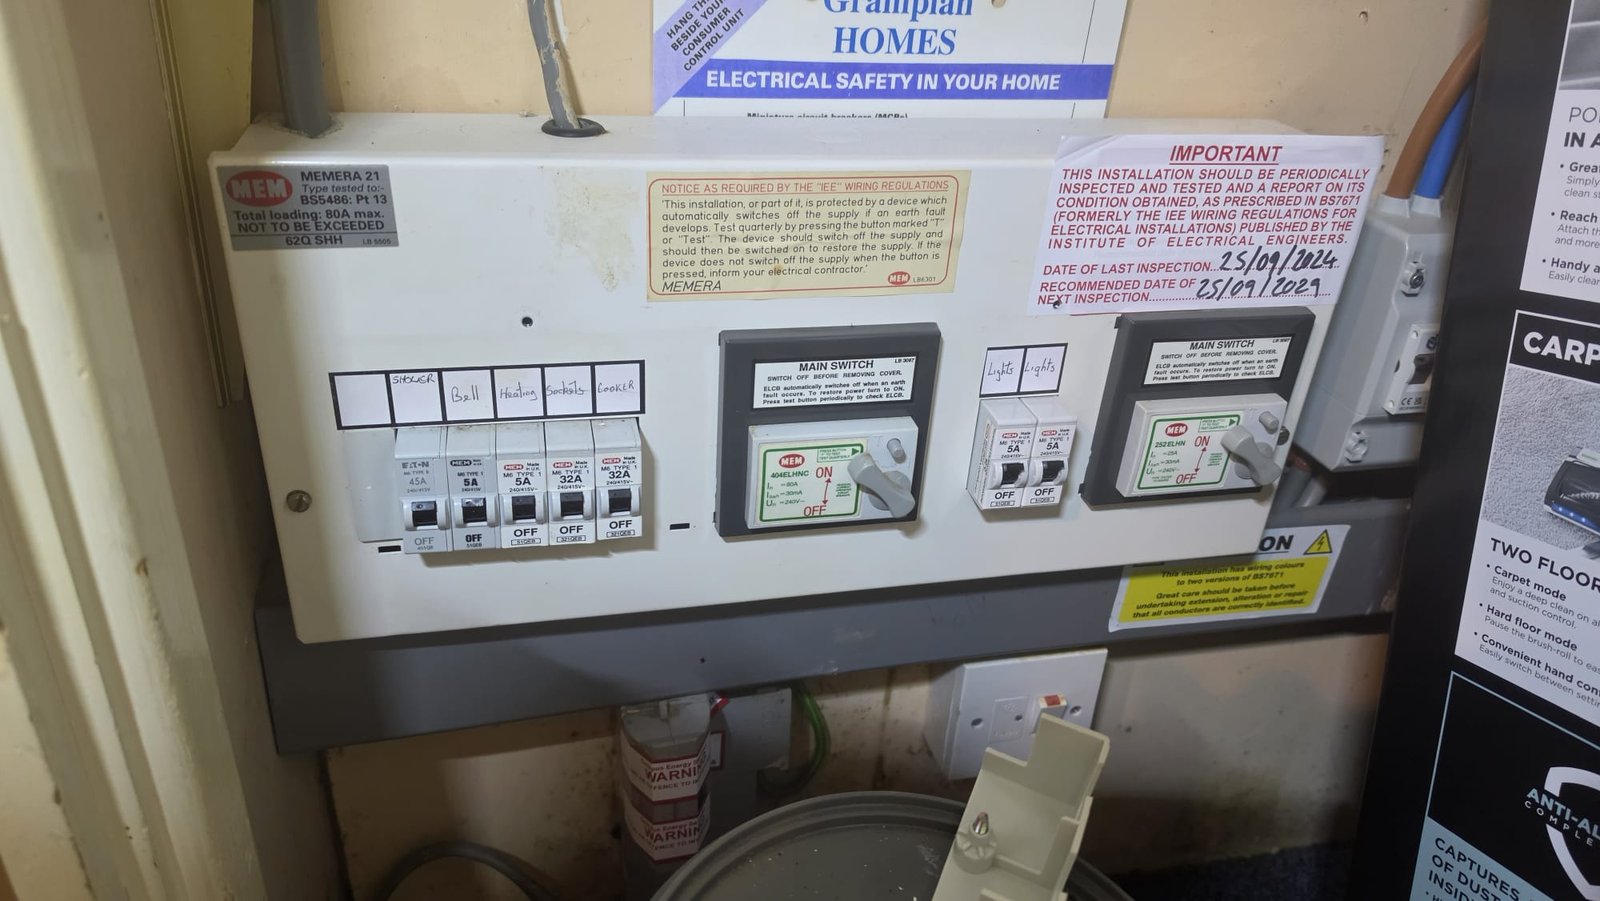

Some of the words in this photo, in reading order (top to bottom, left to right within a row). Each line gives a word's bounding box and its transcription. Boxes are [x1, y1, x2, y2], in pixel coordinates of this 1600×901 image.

[667, 11, 693, 39] HANG
[671, 19, 702, 51] BESIDE
[682, 7, 731, 56] CONSUMER
[684, 34, 724, 71] CONTROL
[722, 8, 744, 32] UNIT
[832, 27, 956, 55] HOMES
[707, 70, 832, 89] ELECTRICAL
[836, 72, 914, 89] SAFETY
[917, 73, 938, 90] IN
[943, 74, 998, 90] YOUR
[1002, 74, 1061, 90] HOME
[1564, 132, 1585, 148] IN
[1170, 145, 1283, 161] IMPORTANT
[300, 171, 362, 182] MEMERA
[365, 171, 379, 181] 21
[1063, 169, 1092, 180] THIS
[1098, 168, 1194, 180] INSTALLATION
[1198, 169, 1253, 180] SHOULD
[1257, 169, 1276, 180] BE
[1279, 169, 1370, 179] PERIODICALLY
[231, 180, 287, 199] MEM
[302, 184, 328, 193] Type
[331, 183, 364, 193] tested
[662, 184, 700, 194] NOTICE
[703, 184, 718, 193] AS
[721, 183, 774, 193] REQUIRED
[777, 183, 790, 192] BY
[794, 182, 813, 192] THE
[844, 181, 878, 191] WIRING
[881, 180, 949, 190] REGULATIONS
[1059, 183, 1135, 194] INSPECTED
[1138, 182, 1168, 194] AND
[1173, 182, 1222, 193] TESTED
[1225, 182, 1254, 193] AND
[1257, 182, 1265, 193] A
[1270, 182, 1323, 193] REPORT
[1325, 182, 1344, 193] ON
[1346, 182, 1365, 193] ITS
[1564, 188, 1590, 197] clean
[300, 194, 352, 205] BS5486:
[356, 194, 369, 205] Pt
[373, 194, 387, 204] 13
[689, 199, 746, 209] installation,
[761, 199, 781, 209] part
[783, 198, 793, 208] of
[816, 197, 863, 208] protected
[865, 197, 877, 207] by
[887, 197, 918, 206] device
[920, 196, 947, 205] which
[233, 210, 266, 220] Total
[269, 209, 322, 221] loading:
[325, 209, 351, 219] 80A
[354, 211, 384, 219] max.
[1560, 210, 1598, 224] Reach
[238, 223, 266, 232] NOT
[270, 222, 290, 232] TO
[293, 221, 311, 232] BE
[314, 220, 384, 231] EXCEEDED
[1557, 224, 1589, 236] Attach
[286, 236, 312, 245] 62Q
[314, 235, 344, 245] SHH
[1220, 245, 1338, 276] 25/09/2024
[1551, 258, 1590, 274] Handy
[1043, 264, 1077, 275] DATE
[1080, 264, 1098, 274] OF
[1101, 263, 1135, 274] LAST
[889, 274, 908, 283] MEM
[1548, 270, 1575, 284] Easily
[662, 280, 721, 292] MEMERA
[1040, 280, 1141, 292] RECOMMENDED
[1143, 279, 1176, 289] DATE
[1179, 279, 1197, 288] OF
[1196, 277, 1320, 301] 25/09/2029
[1037, 294, 1072, 305] NEXT
[1189, 341, 1215, 350] MAIN
[1216, 340, 1255, 349] SWITCH
[1524, 332, 1600, 365] CARP
[799, 362, 828, 372] MAIN
[830, 360, 874, 370] SWITCH
[988, 361, 1014, 381] Lights
[1024, 358, 1056, 377] Lights
[452, 385, 480, 403] Bell
[500, 386, 538, 401] Heating
[1166, 424, 1186, 435] MEM
[1194, 436, 1210, 447] ON
[781, 457, 803, 465] MEM
[608, 470, 630, 479] 32A
[816, 466, 832, 478] ON
[409, 477, 427, 485] 45A
[464, 478, 478, 486] 5A
[515, 477, 531, 486] 5A
[559, 474, 582, 483] 32A
[1176, 473, 1197, 484] OFF
[994, 491, 1015, 500] OFF
[1034, 488, 1056, 496] OFF
[804, 505, 827, 517] OFF
[559, 525, 584, 534] OFF
[609, 520, 633, 529] OFF
[466, 534, 482, 543] OFF
[513, 528, 538, 537] OFF
[414, 536, 434, 545] OFF
[1180, 567, 1227, 577] installation
[1247, 564, 1273, 573] wiring
[1491, 537, 1532, 564] TWO
[1538, 556, 1600, 593] FLOOR
[1494, 565, 1530, 587] Carpet
[1533, 582, 1566, 601] mode
[1202, 587, 1231, 596] should
[1487, 604, 1512, 622] Hard
[1515, 617, 1542, 635] floor
[1544, 631, 1578, 652] mode
[1481, 634, 1542, 668] Convenient
[1544, 663, 1574, 683] hand
[1526, 788, 1600, 840] ANTI-AL
[1432, 855, 1454, 873] OF
[1435, 837, 1520, 901] CAPTURES
